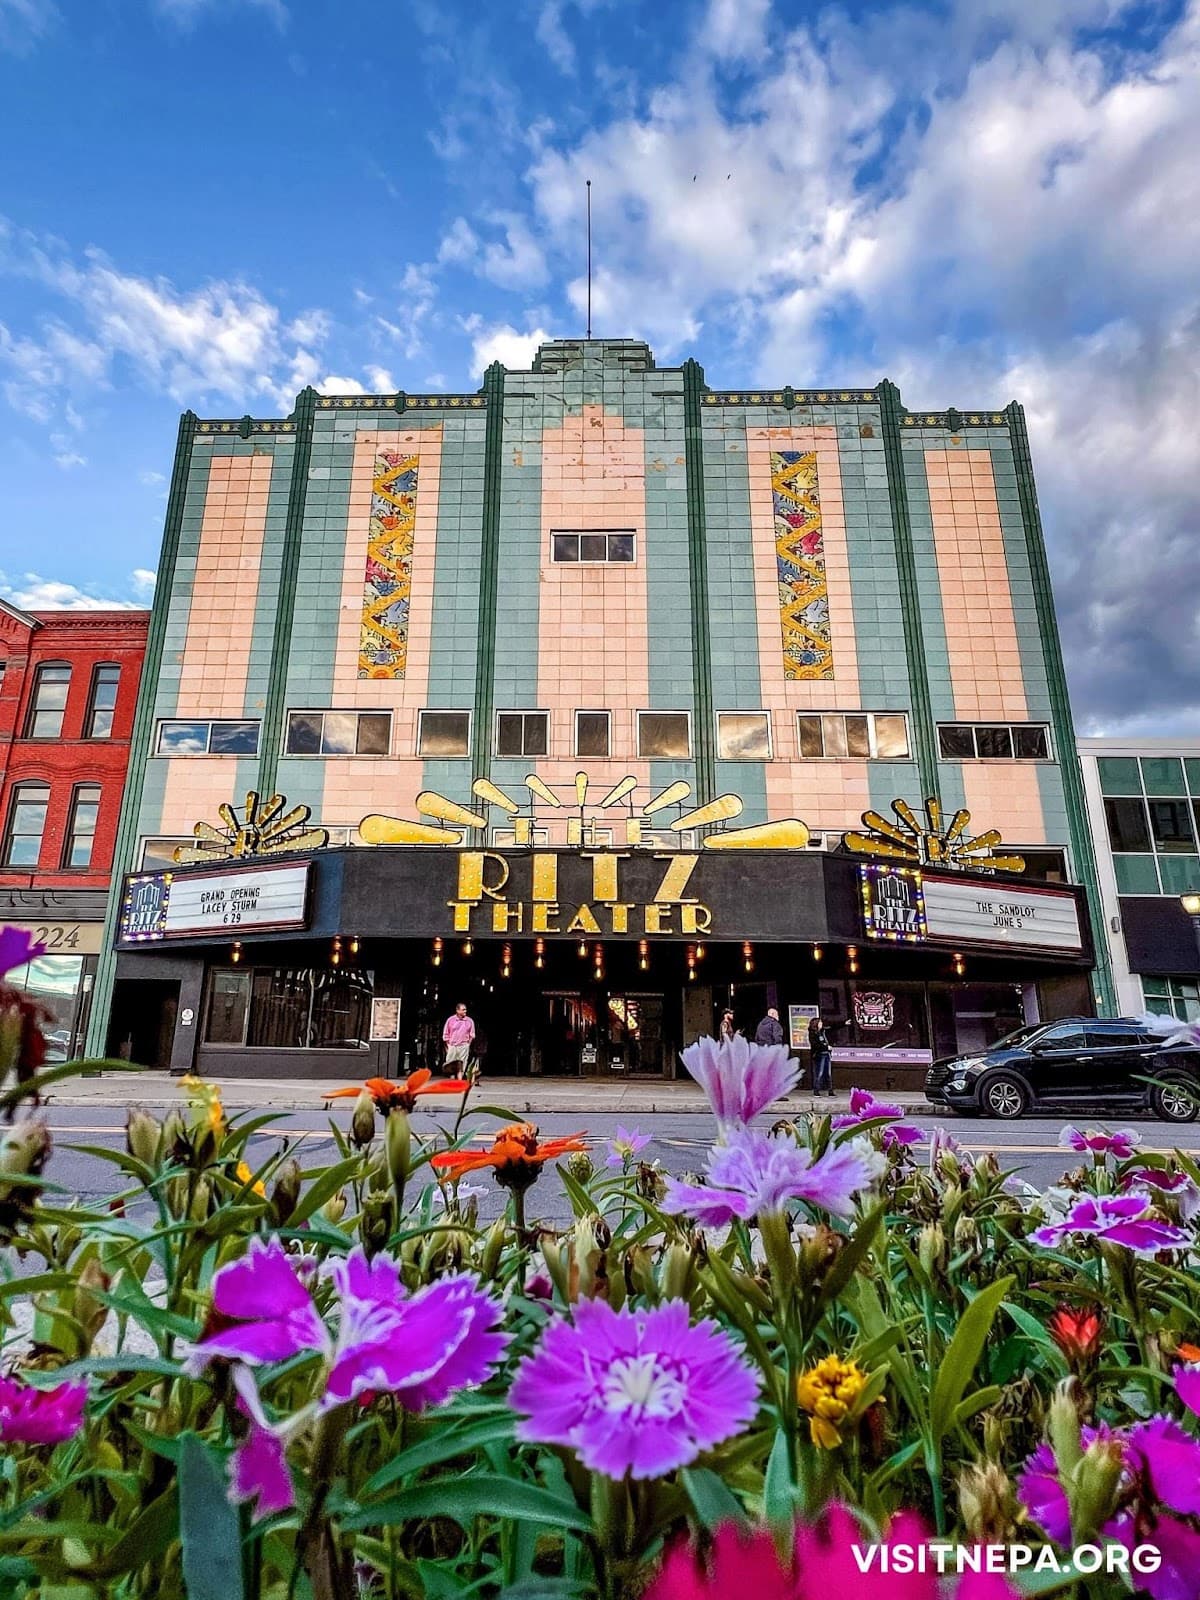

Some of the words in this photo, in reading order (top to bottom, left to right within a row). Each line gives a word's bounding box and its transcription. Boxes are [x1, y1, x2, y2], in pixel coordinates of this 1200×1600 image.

[507, 816, 654, 845] THE
[458, 851, 700, 904] RITZ
[200, 891, 225, 903] GRAND
[230, 887, 261, 900] OPENING
[884, 897, 904, 907] THE
[202, 902, 227, 914] LACEY
[231, 899, 257, 911] STURM
[873, 904, 918, 924] RITZ
[976, 902, 993, 913] THE
[999, 904, 1035, 918] SANDLOT
[130, 910, 161, 925] RITZ
[223, 914, 228, 924] 6
[231, 913, 241, 923] 29
[447, 901, 712, 934] THEATER
[993, 916, 1014, 927] JUNE
[1017, 918, 1022, 928] 5
[874, 919, 918, 932] THEATER
[32, 924, 81, 948] 224
[863, 1015, 887, 1024] Y2K
